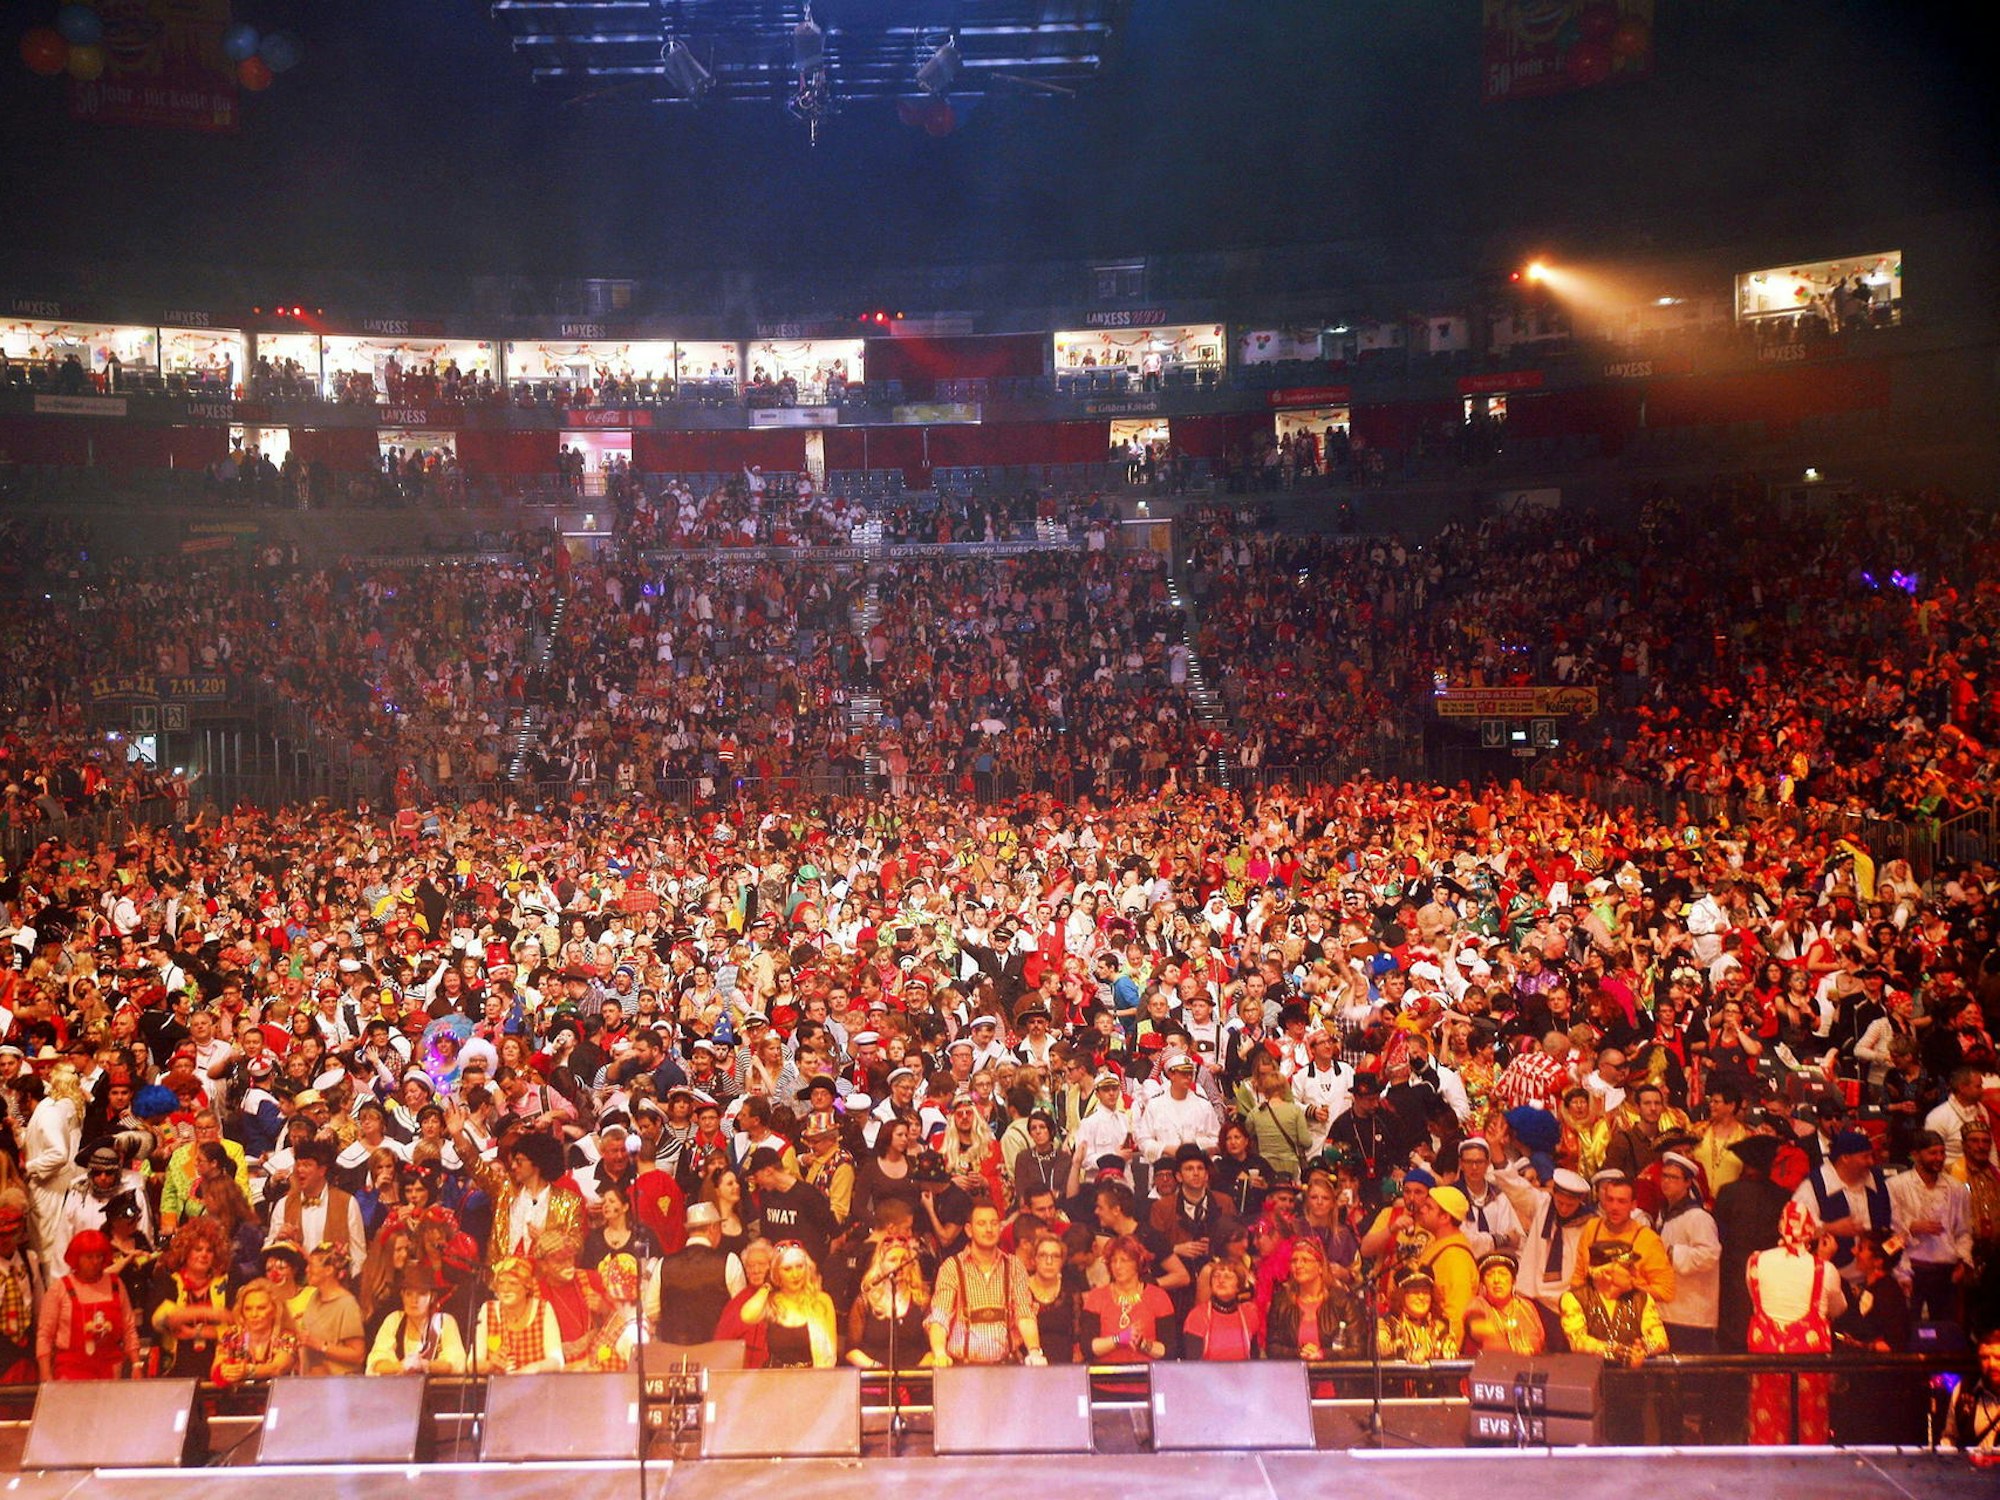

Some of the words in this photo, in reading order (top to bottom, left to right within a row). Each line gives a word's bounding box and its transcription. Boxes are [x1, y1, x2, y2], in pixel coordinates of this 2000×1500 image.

[12, 299, 61, 317] LANXESS
[163, 310, 210, 326] LANXESS
[1086, 311, 1131, 326] LANXESS
[363, 319, 409, 334] LANXESS
[561, 323, 606, 338] LANXESS
[756, 323, 801, 338] LANXESS
[1604, 361, 1653, 377] LANXESS
[187, 403, 234, 419] LANXESS
[381, 409, 427, 424] LANXESS
[766, 1207, 798, 1225] SWAT
[645, 1379, 664, 1395] VS
[1474, 1383, 1505, 1401] EVS
[1479, 1417, 1510, 1435] EVS
